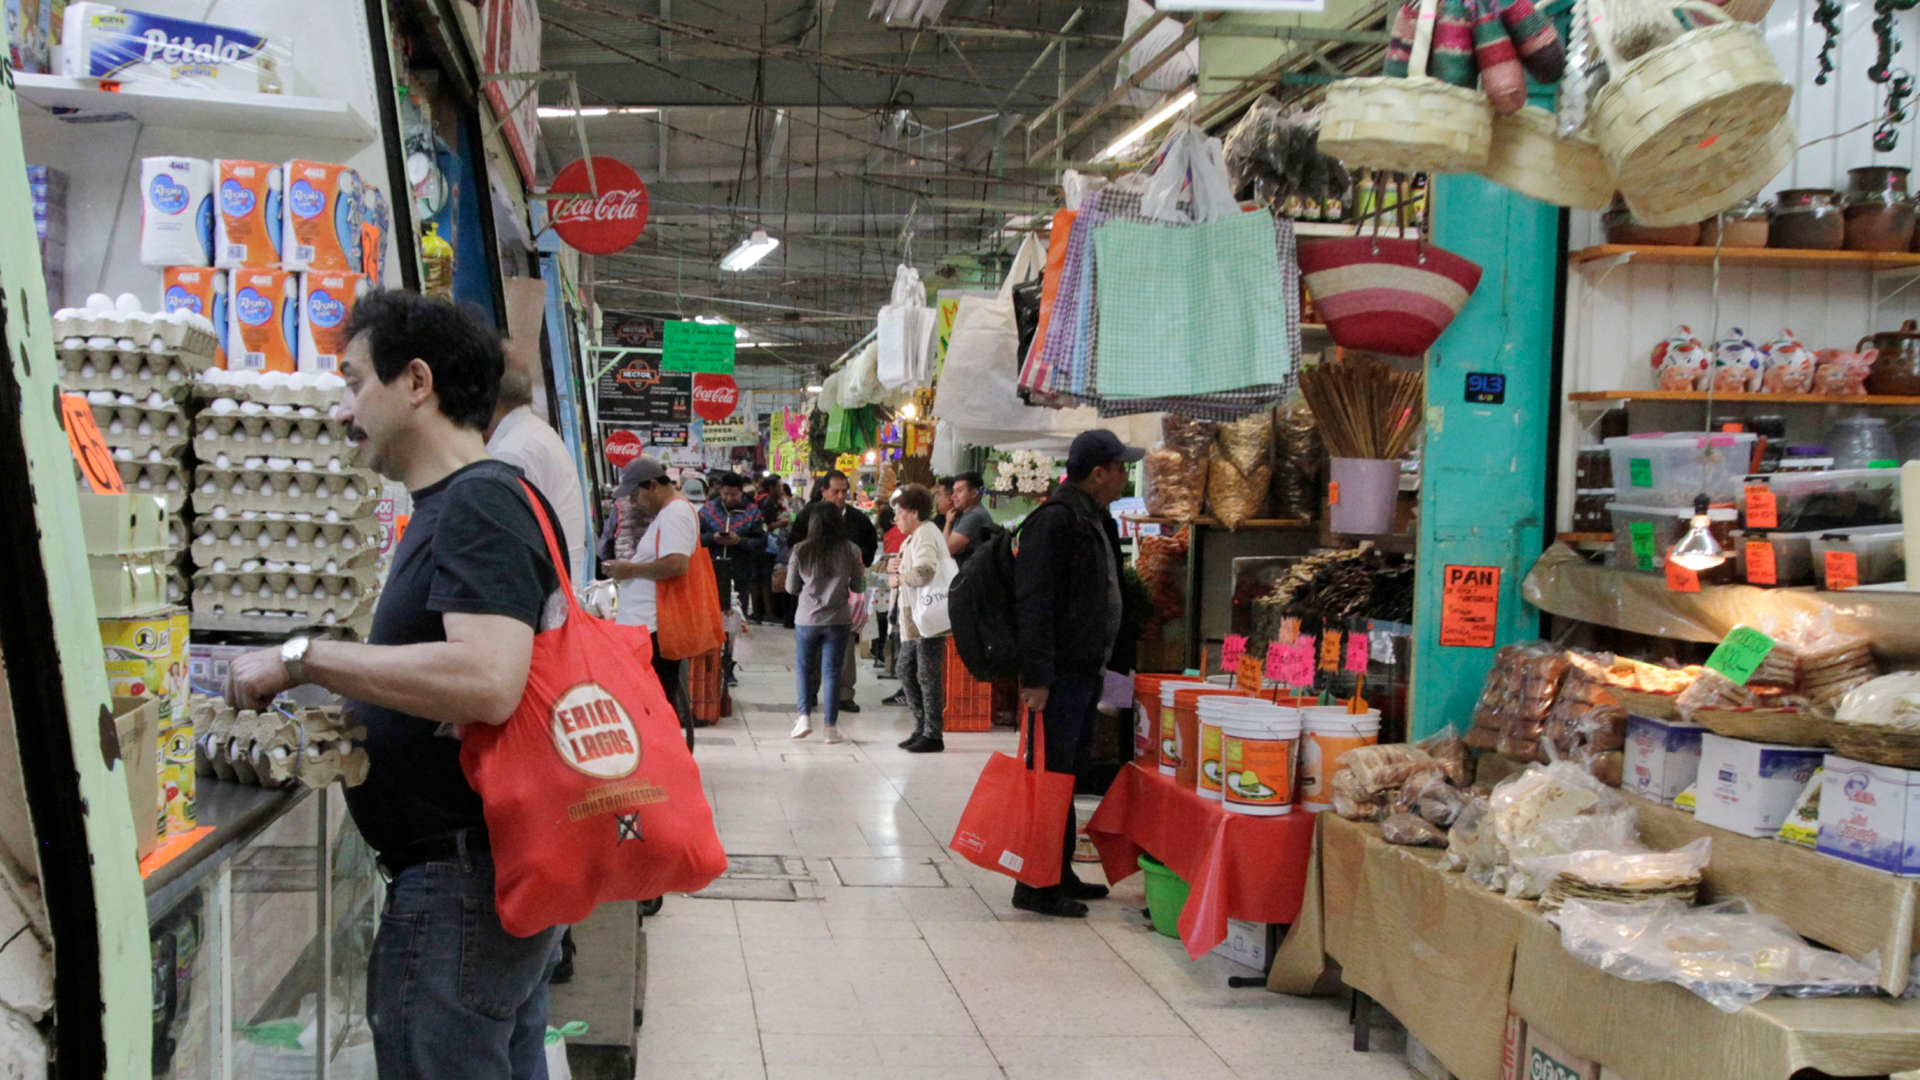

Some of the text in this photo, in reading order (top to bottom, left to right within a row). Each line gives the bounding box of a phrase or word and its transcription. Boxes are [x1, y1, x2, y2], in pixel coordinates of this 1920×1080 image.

[143, 29, 239, 65] Pétalo
[622, 371, 653, 379] HECTOR
[692, 385, 736, 404] Coca-Cola
[605, 442, 640, 455] Coca-Cola
[1451, 568, 1493, 586] PAN
[557, 699, 621, 735] ERICH
[570, 729, 635, 764] LAGOS
[568, 793, 629, 821] DIPUTADO
